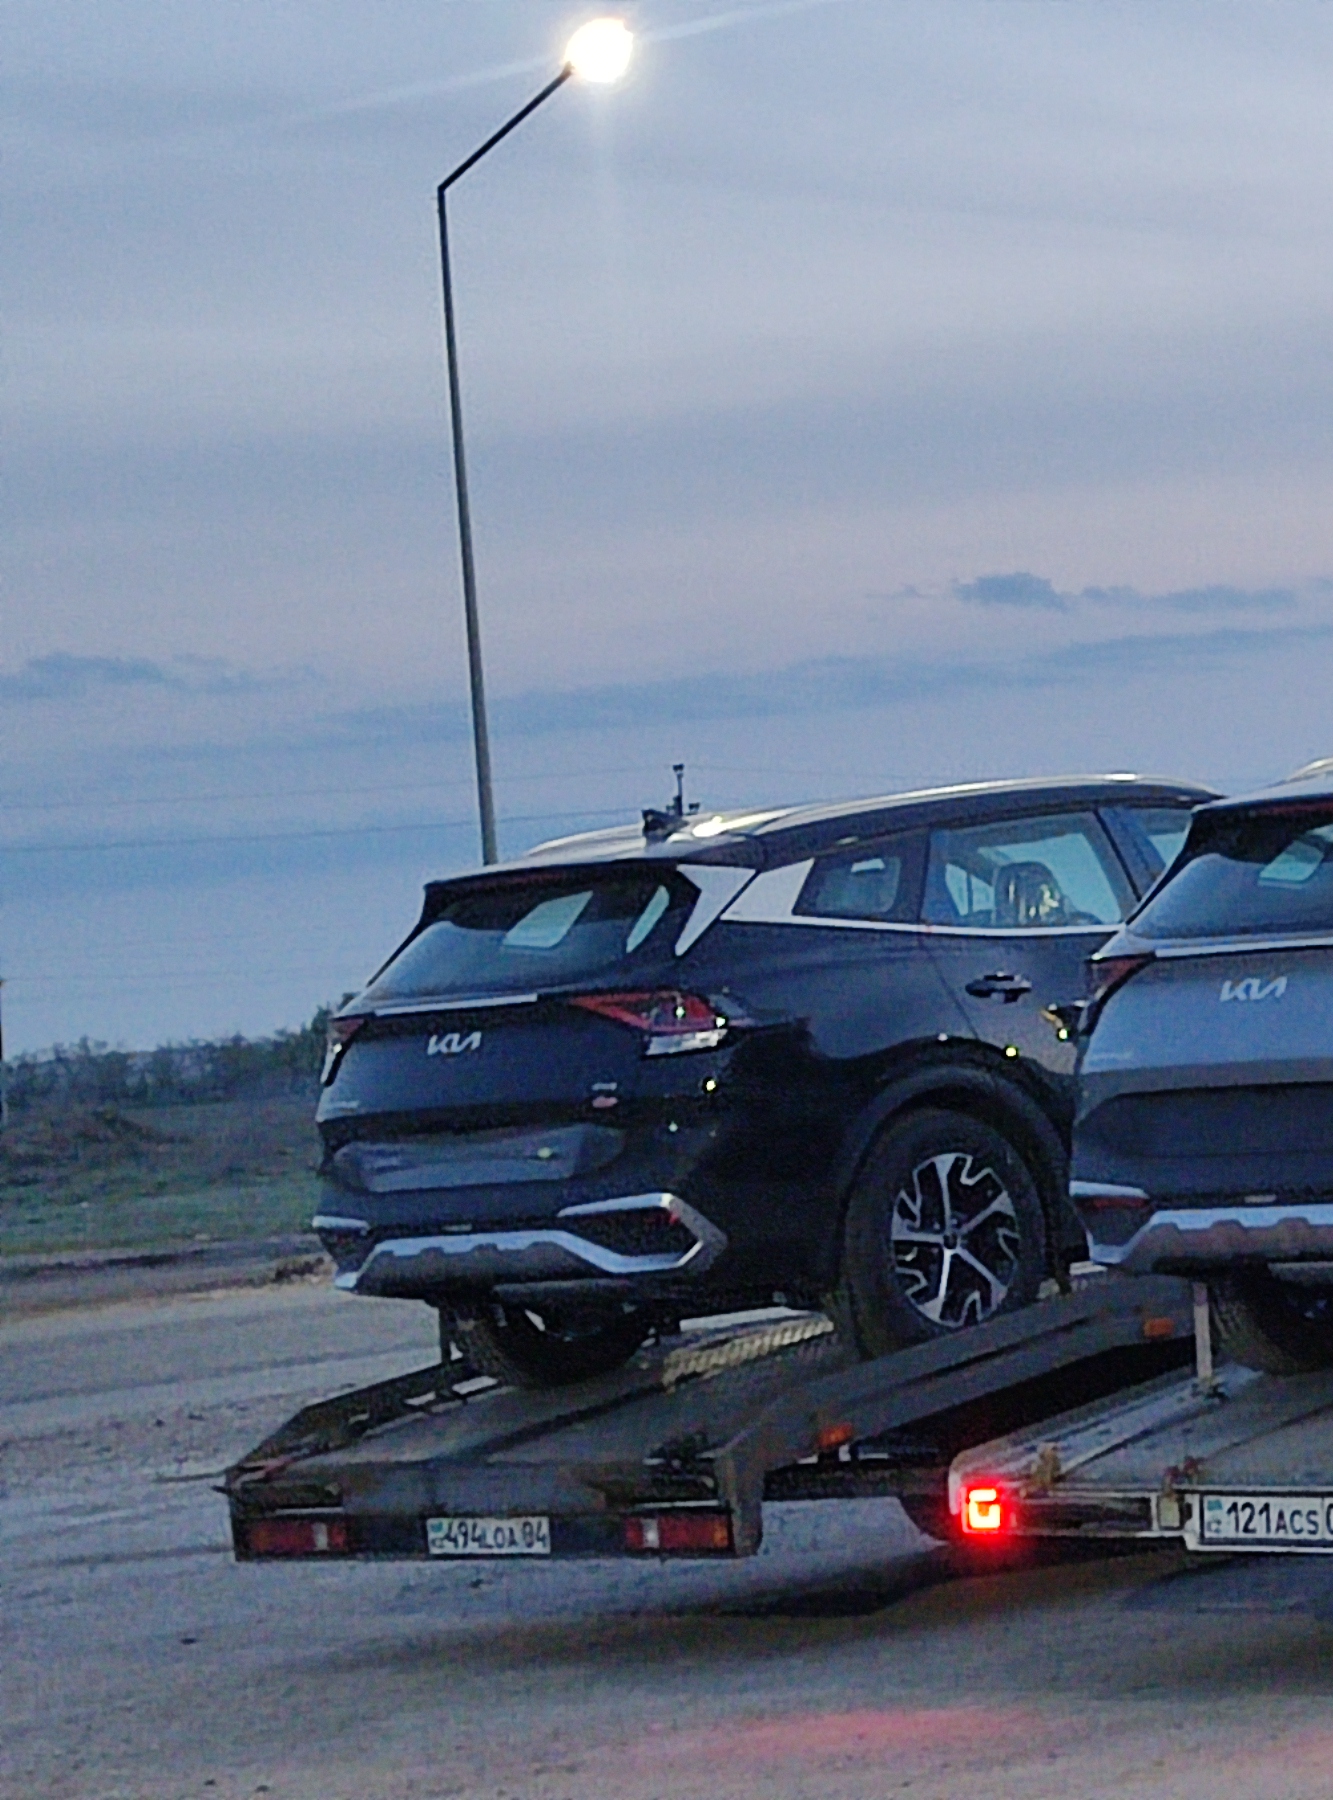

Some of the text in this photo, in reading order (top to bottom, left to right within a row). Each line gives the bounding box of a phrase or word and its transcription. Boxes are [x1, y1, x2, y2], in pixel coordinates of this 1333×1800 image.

[1219, 976, 1288, 1002] KIA
[427, 1031, 482, 1056] KIA
[1227, 1501, 1320, 1536] 121ACS
